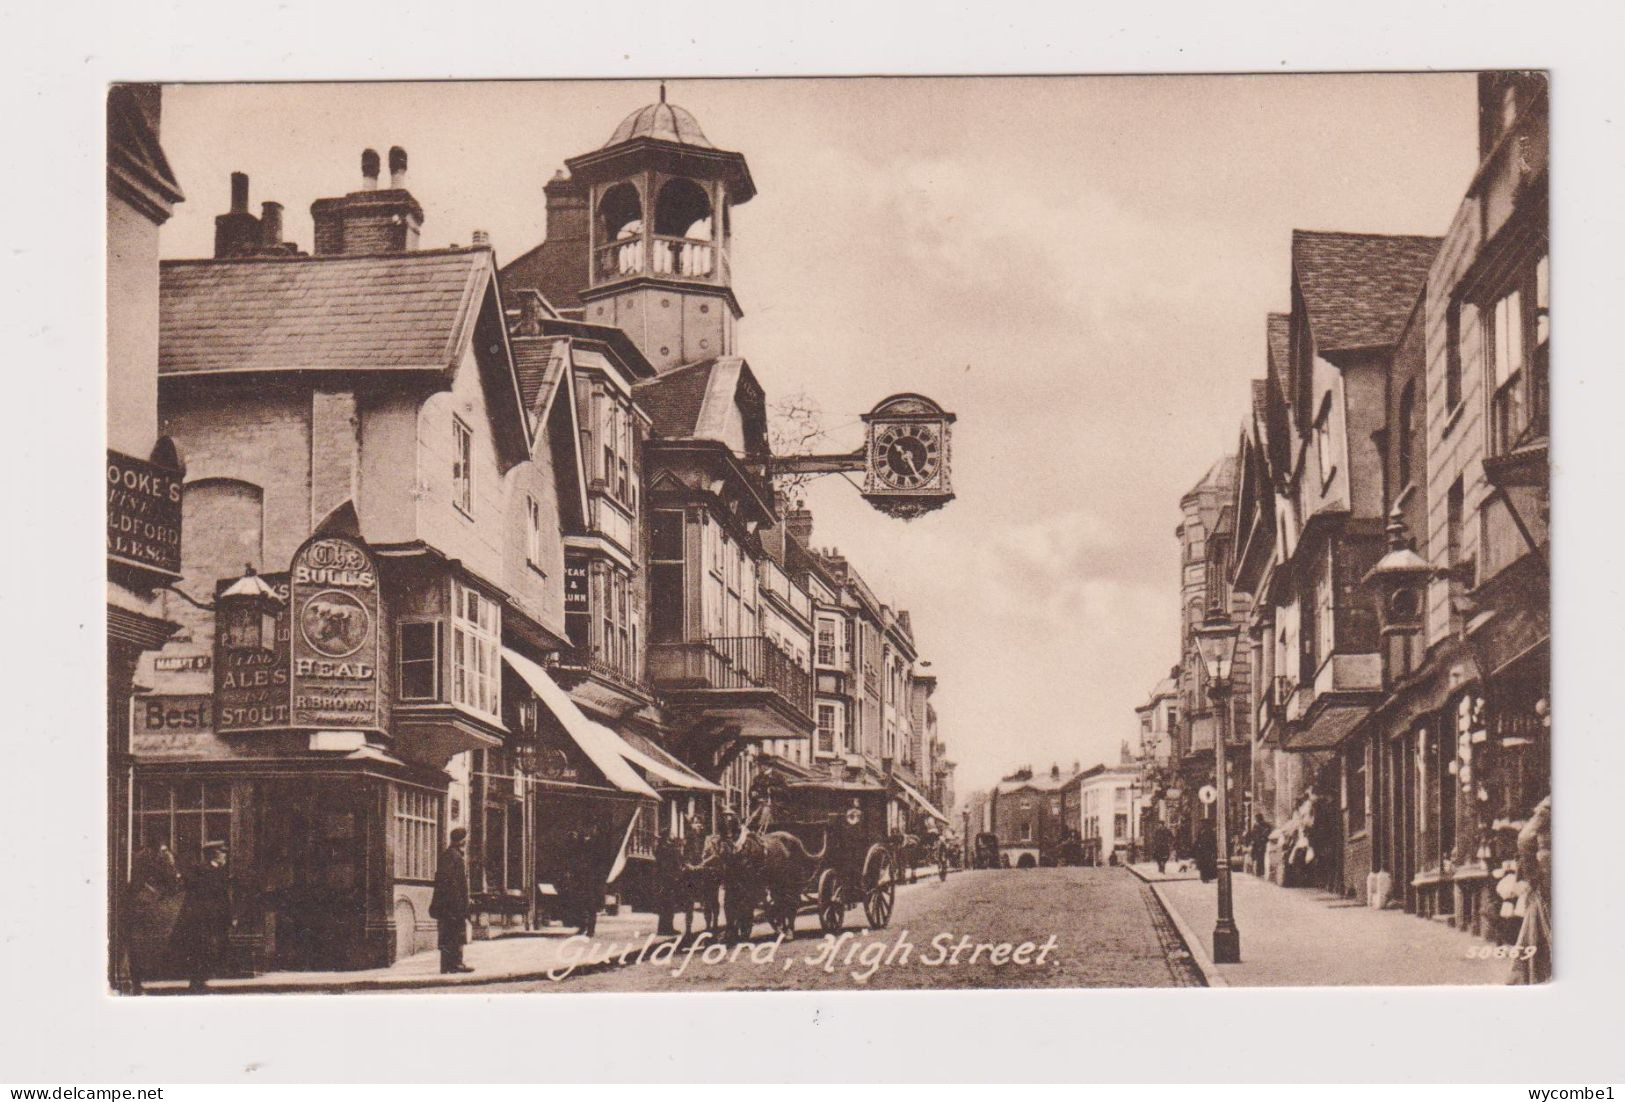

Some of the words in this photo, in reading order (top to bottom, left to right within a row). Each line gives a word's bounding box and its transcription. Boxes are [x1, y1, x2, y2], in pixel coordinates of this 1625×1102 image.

[223, 668, 288, 689] ALES
[295, 660, 373, 679] HEAD
[146, 701, 212, 730] Best
[221, 704, 288, 725] STOUT
